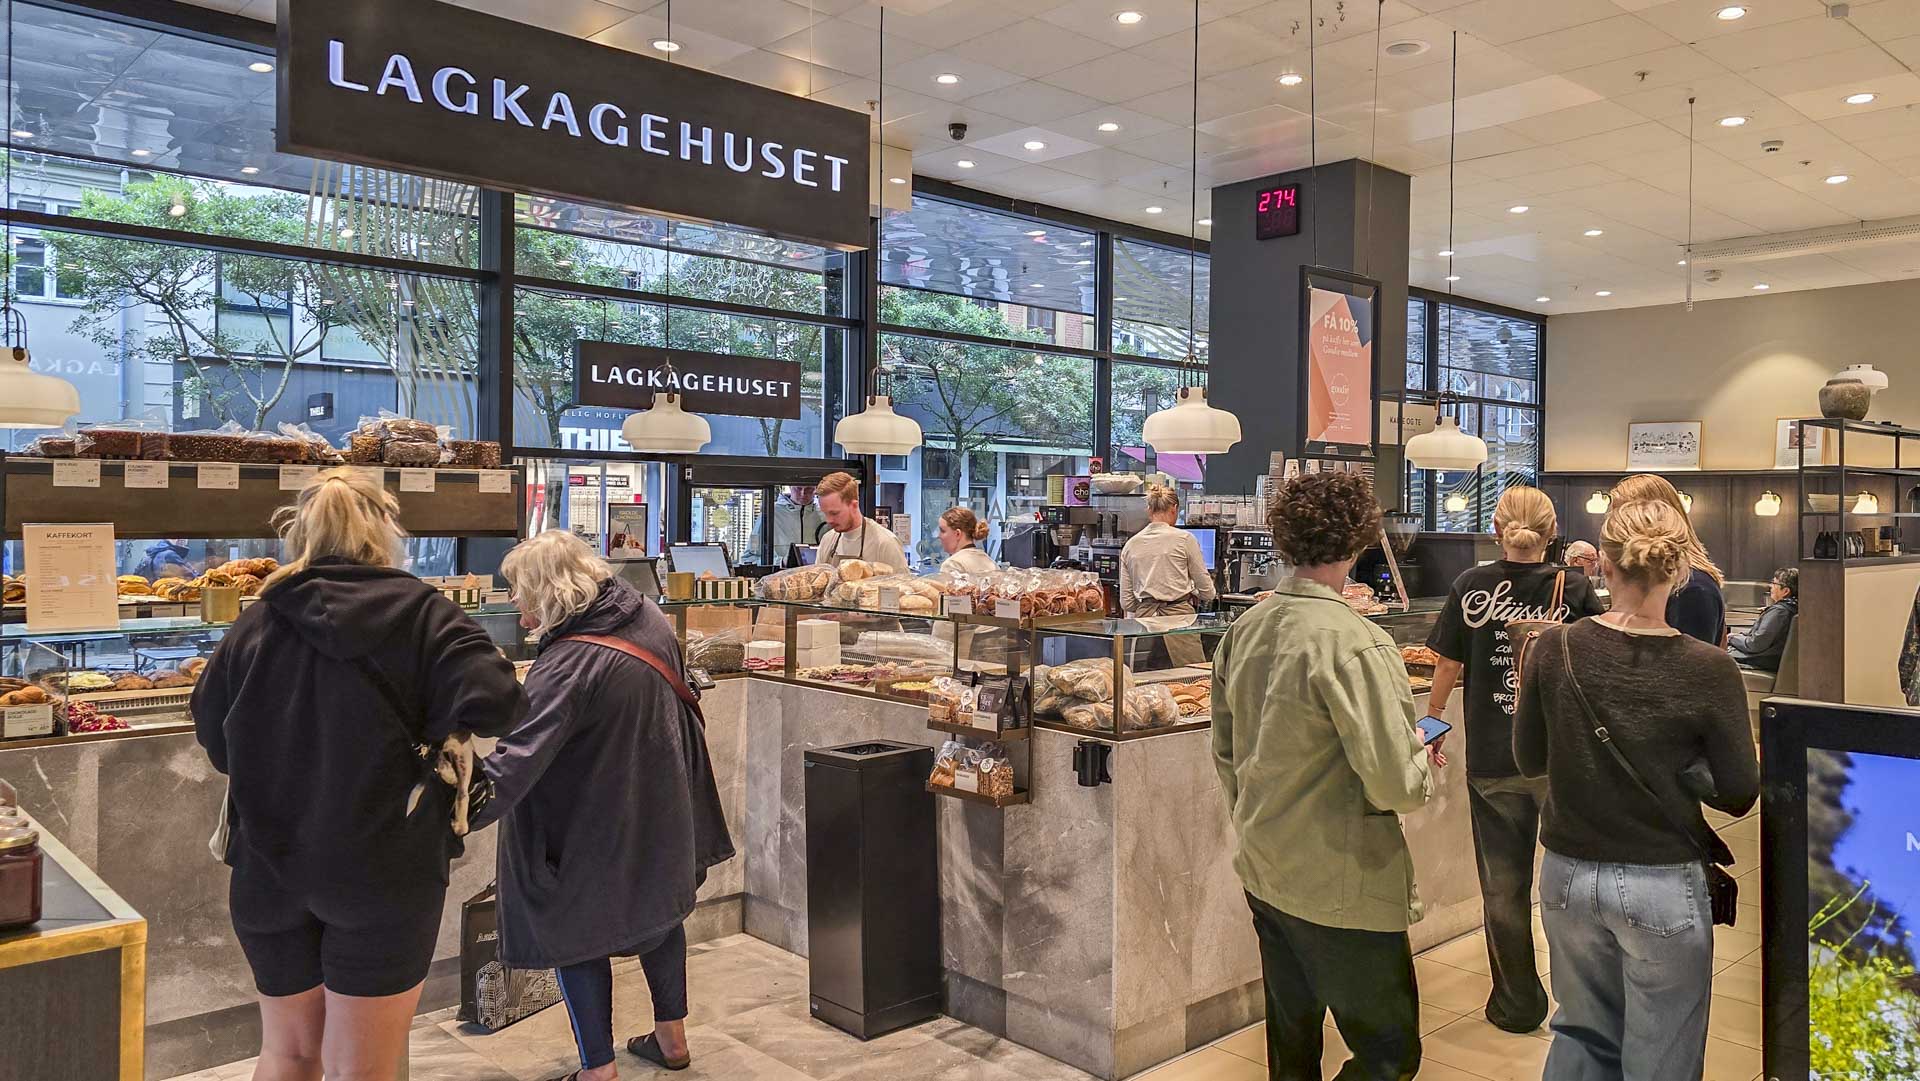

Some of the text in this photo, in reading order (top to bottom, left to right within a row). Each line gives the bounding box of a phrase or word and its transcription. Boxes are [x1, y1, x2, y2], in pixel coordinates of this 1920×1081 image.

[329, 39, 849, 192] LAGKAGEHUSET
[1324, 312, 1359, 334] FÅ 10%
[591, 364, 792, 398] LAGKAGEHUSET
[1390, 416, 1406, 425] KAE
